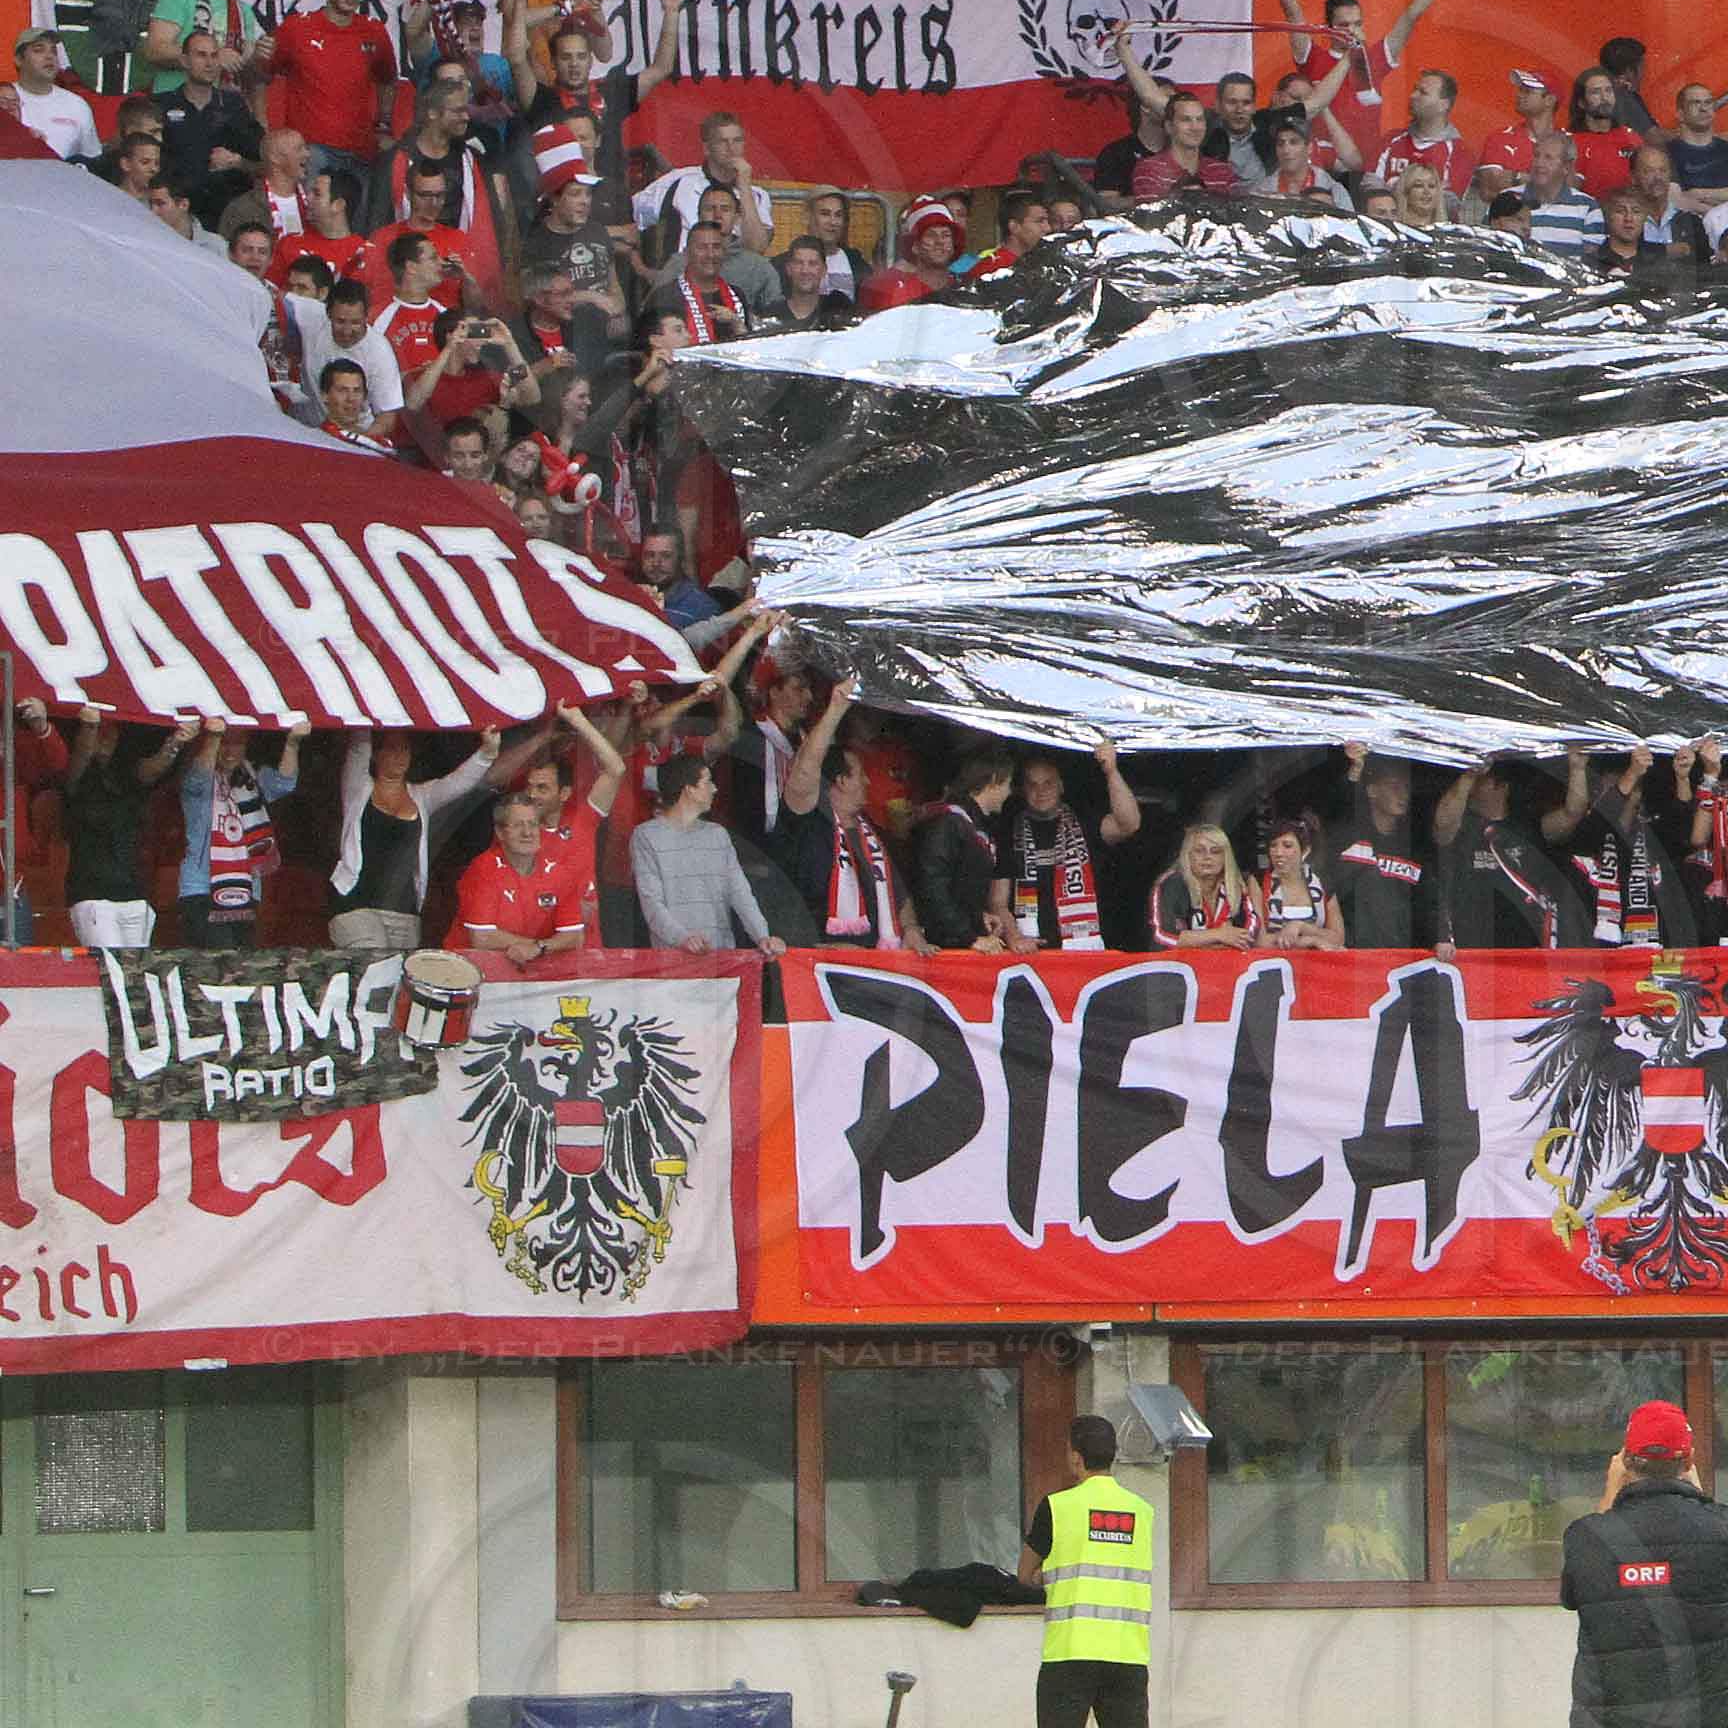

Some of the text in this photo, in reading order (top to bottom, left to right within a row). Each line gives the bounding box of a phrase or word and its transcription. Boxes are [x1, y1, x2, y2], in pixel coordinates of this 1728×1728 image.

[0, 521, 716, 730] PATRIOTS
[203, 1055, 337, 1112] RATIO
[1624, 1565, 1667, 1583] ORF
